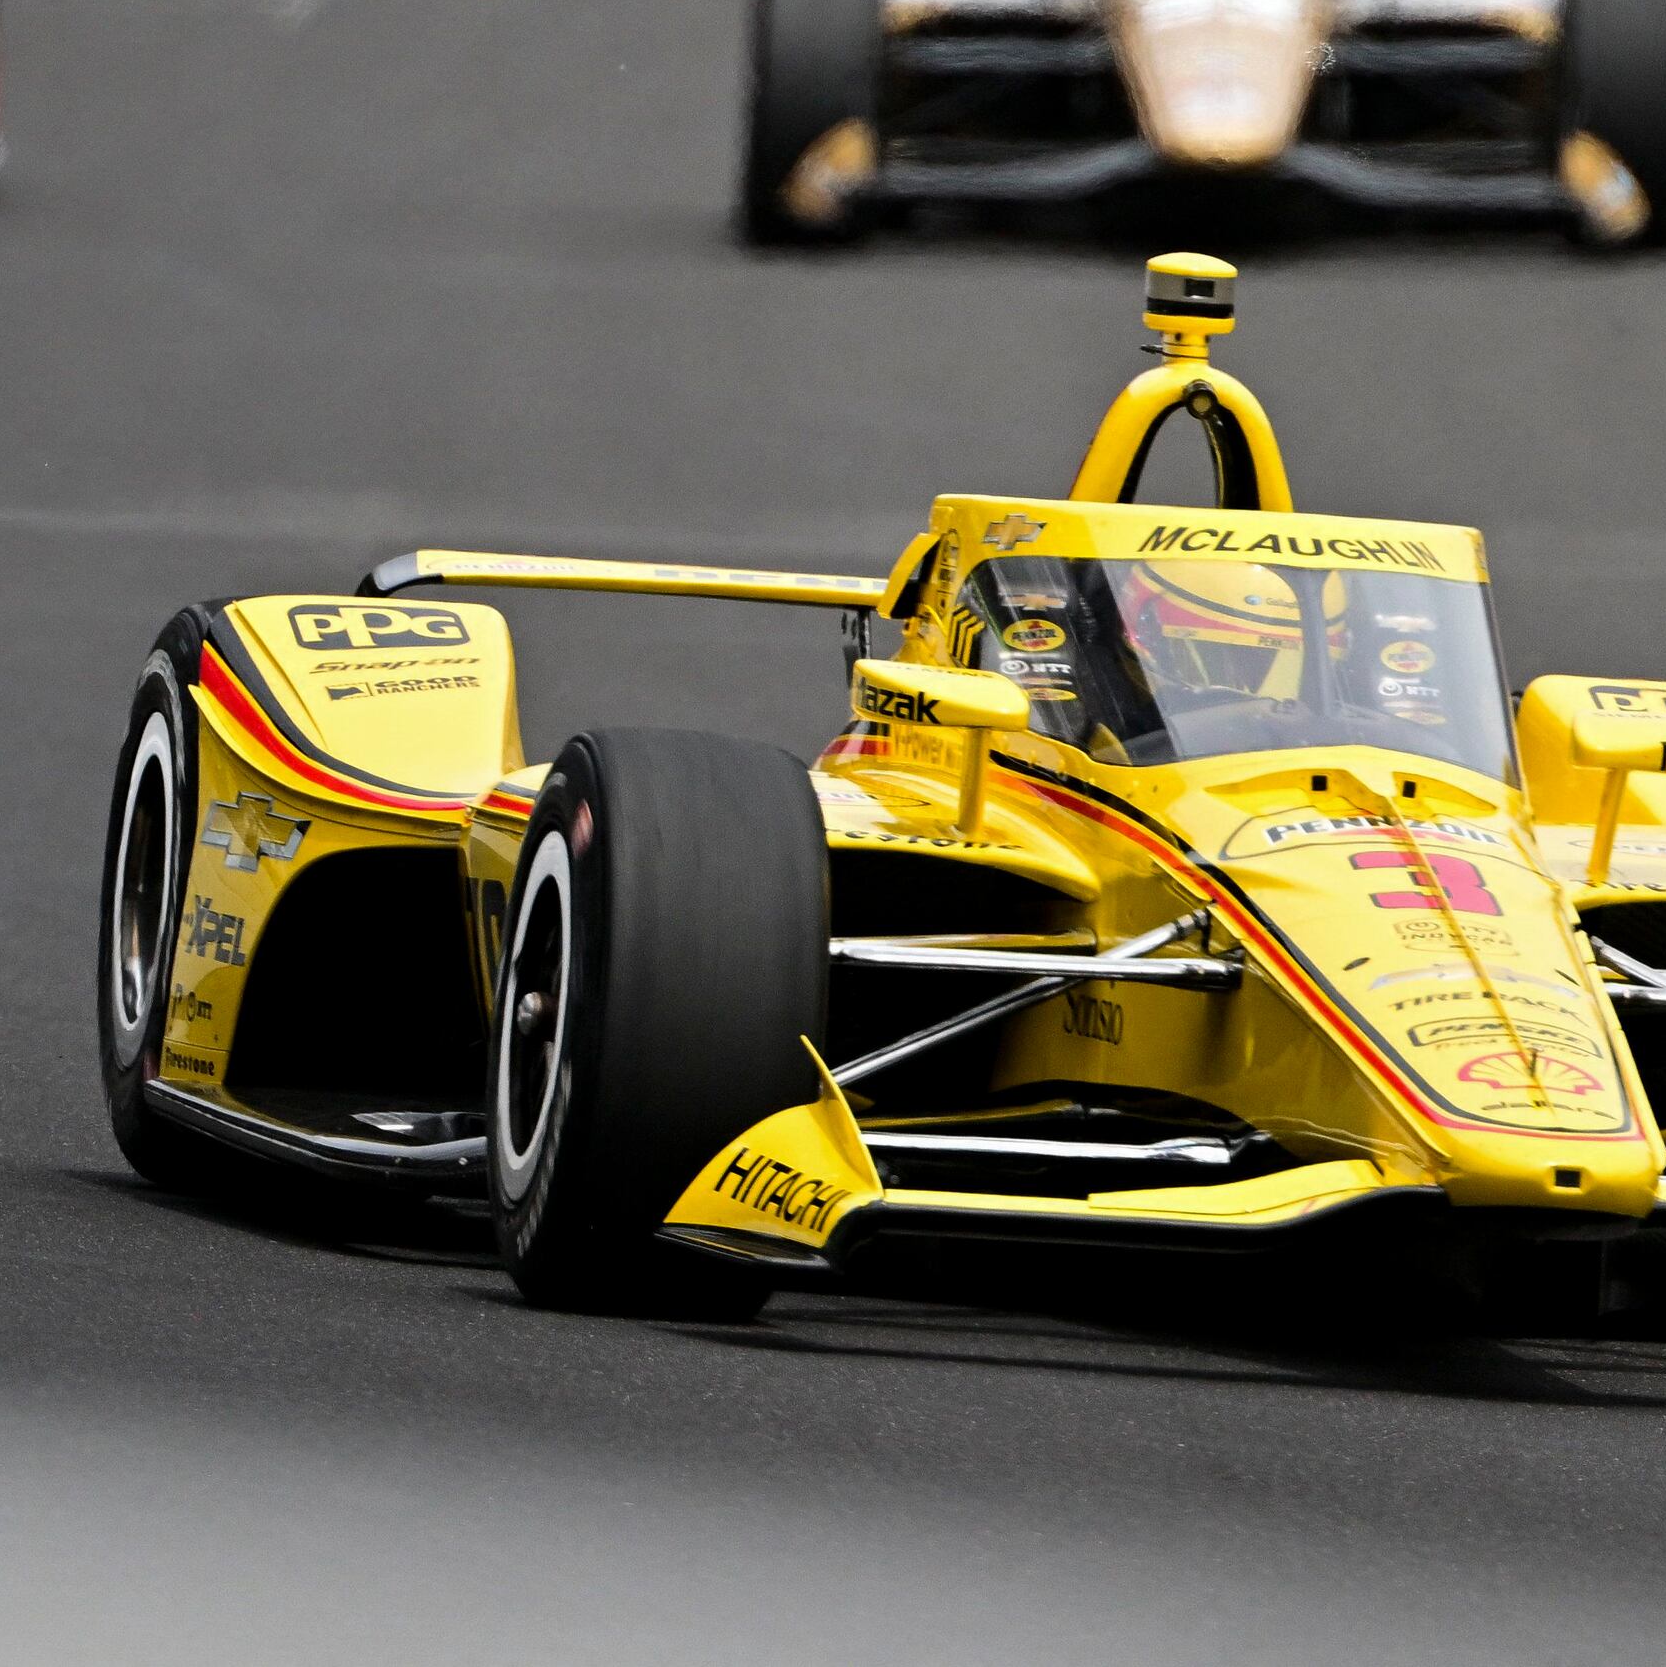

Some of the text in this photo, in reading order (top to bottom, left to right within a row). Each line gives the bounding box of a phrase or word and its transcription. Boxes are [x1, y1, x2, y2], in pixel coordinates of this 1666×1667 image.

[1136, 525, 1447, 573] MCLAUGHLIN
[294, 606, 464, 648] PPG
[375, 675, 478, 688] GOOD
[1031, 663, 1072, 674] NTT
[1265, 814, 1506, 846] PENNZOIL
[1348, 850, 1504, 917] 3
[185, 894, 247, 967] XPEL
[1389, 991, 1474, 1011] TIRE
[713, 1146, 853, 1233] HITACHI
